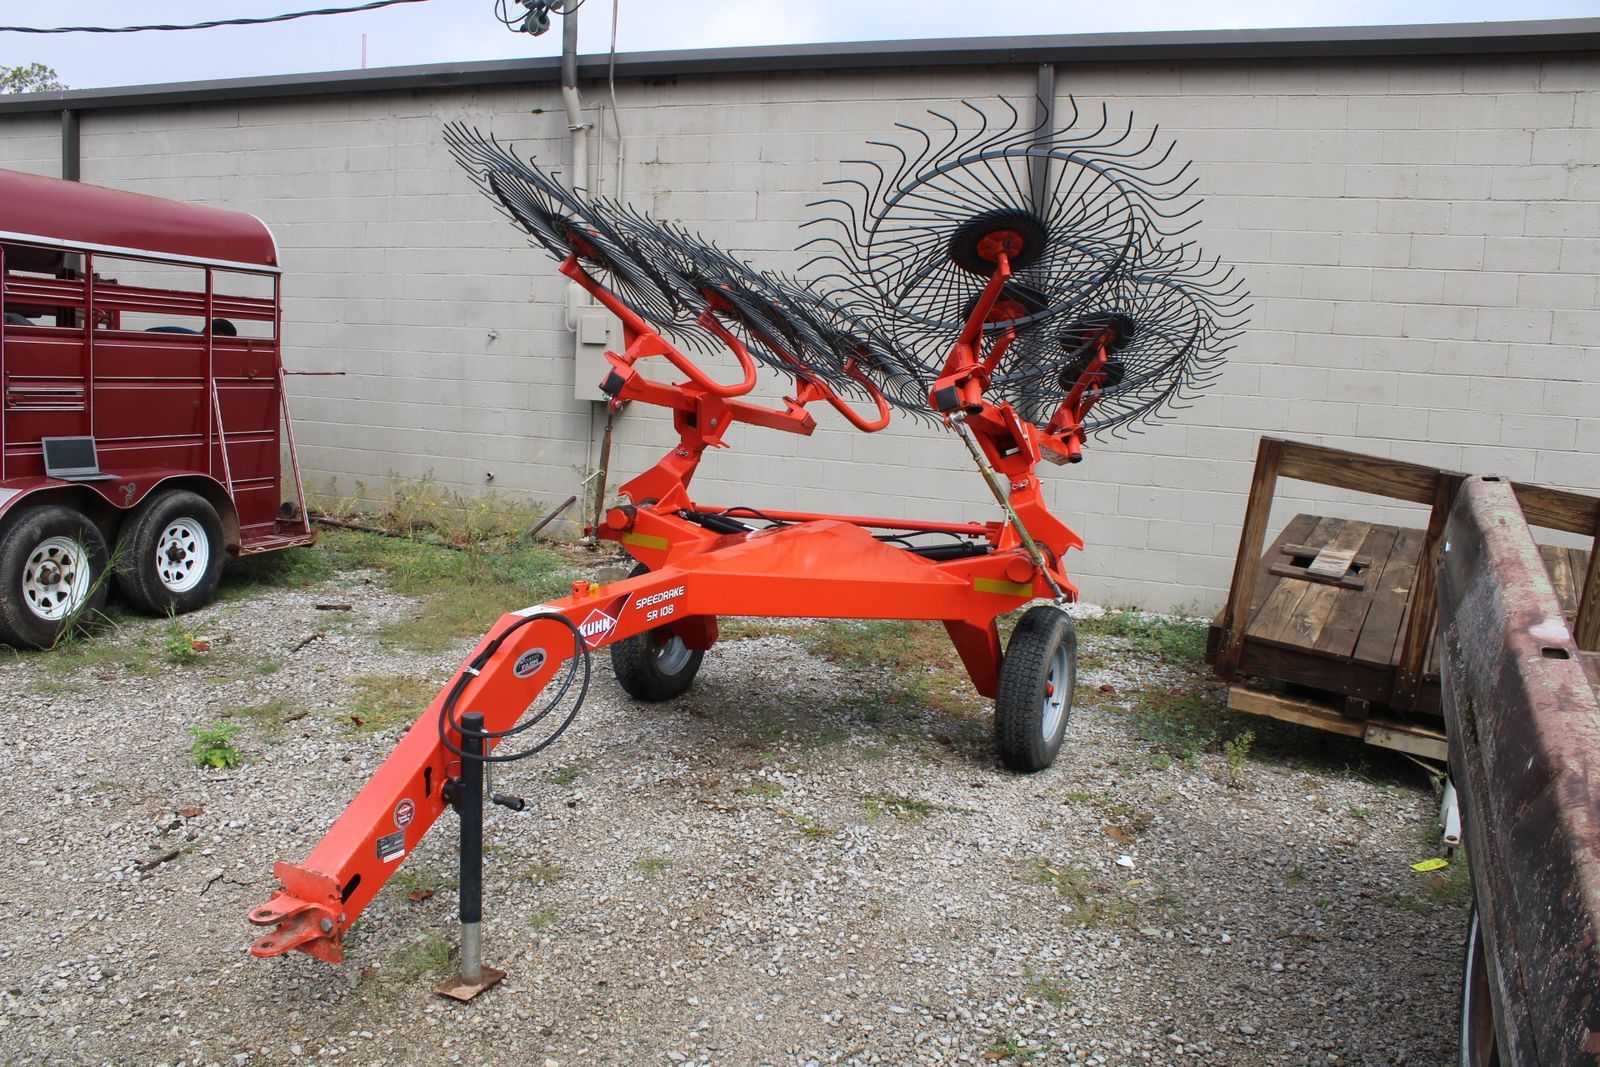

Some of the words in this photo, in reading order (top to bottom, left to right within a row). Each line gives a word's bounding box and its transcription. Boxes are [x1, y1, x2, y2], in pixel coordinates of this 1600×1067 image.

[635, 585, 685, 610] SPEEDRAKE
[646, 610, 658, 622] SR
[660, 604, 674, 618] 108
[579, 617, 611, 638] KUHN
